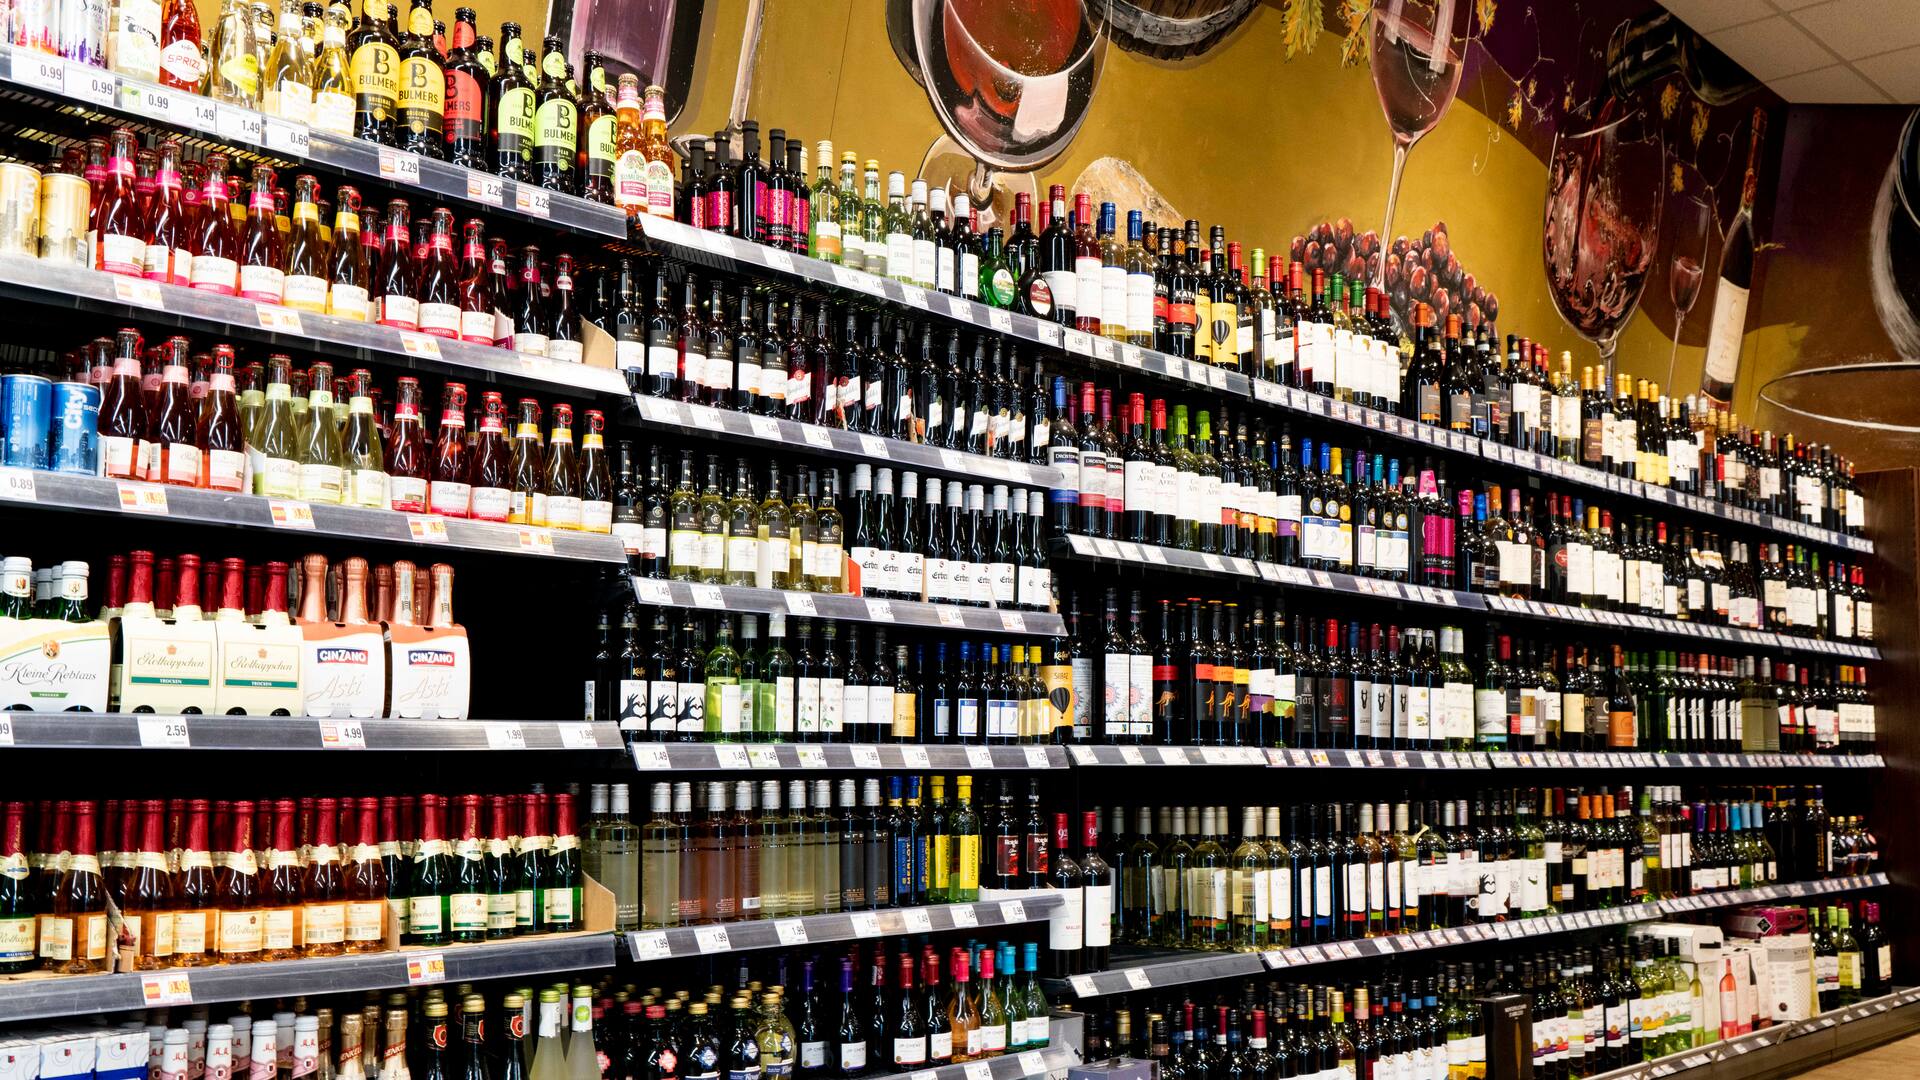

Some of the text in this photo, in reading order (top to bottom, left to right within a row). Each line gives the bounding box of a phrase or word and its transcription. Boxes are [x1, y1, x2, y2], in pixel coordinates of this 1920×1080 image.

[374, 48, 389, 75] B
[41, 65, 62, 80] 0.99
[411, 63, 427, 88] B
[92, 80, 113, 95] 0.99
[359, 75, 397, 92] BULMERS
[148, 94, 168, 109] 0.99
[399, 90, 439, 104] BULMERS
[195, 107, 214, 121] 1.49
[557, 104, 571, 129] B
[242, 120, 260, 134] 1.49
[291, 132, 308, 147] 0.69
[400, 161, 418, 174] 2.29
[487, 184, 502, 196] 2.29
[535, 196, 550, 209] 2.29
[64, 389, 87, 429] City
[10, 478, 33, 490] 0.89
[656, 587, 670, 597] 1.49
[708, 591, 722, 601] 1.29
[801, 600, 814, 609] 1.49
[319, 650, 367, 662] CINZANO
[410, 651, 453, 664] CINZANO
[1, 663, 97, 686] Kleine Reblaus
[306, 673, 362, 702] Asti
[400, 675, 450, 702] Asti
[166, 725, 186, 737] 2.59
[344, 727, 361, 739] 4.99
[506, 729, 522, 740] 1.99
[578, 729, 594, 740] 1.99
[653, 751, 667, 760] 1.49
[733, 751, 746, 760] 1.49
[763, 751, 776, 760] 1.49
[812, 751, 824, 761] 1.49
[791, 925, 805, 935] 1.99
[654, 938, 668, 948] 1.99
[713, 933, 727, 943] 1.99
